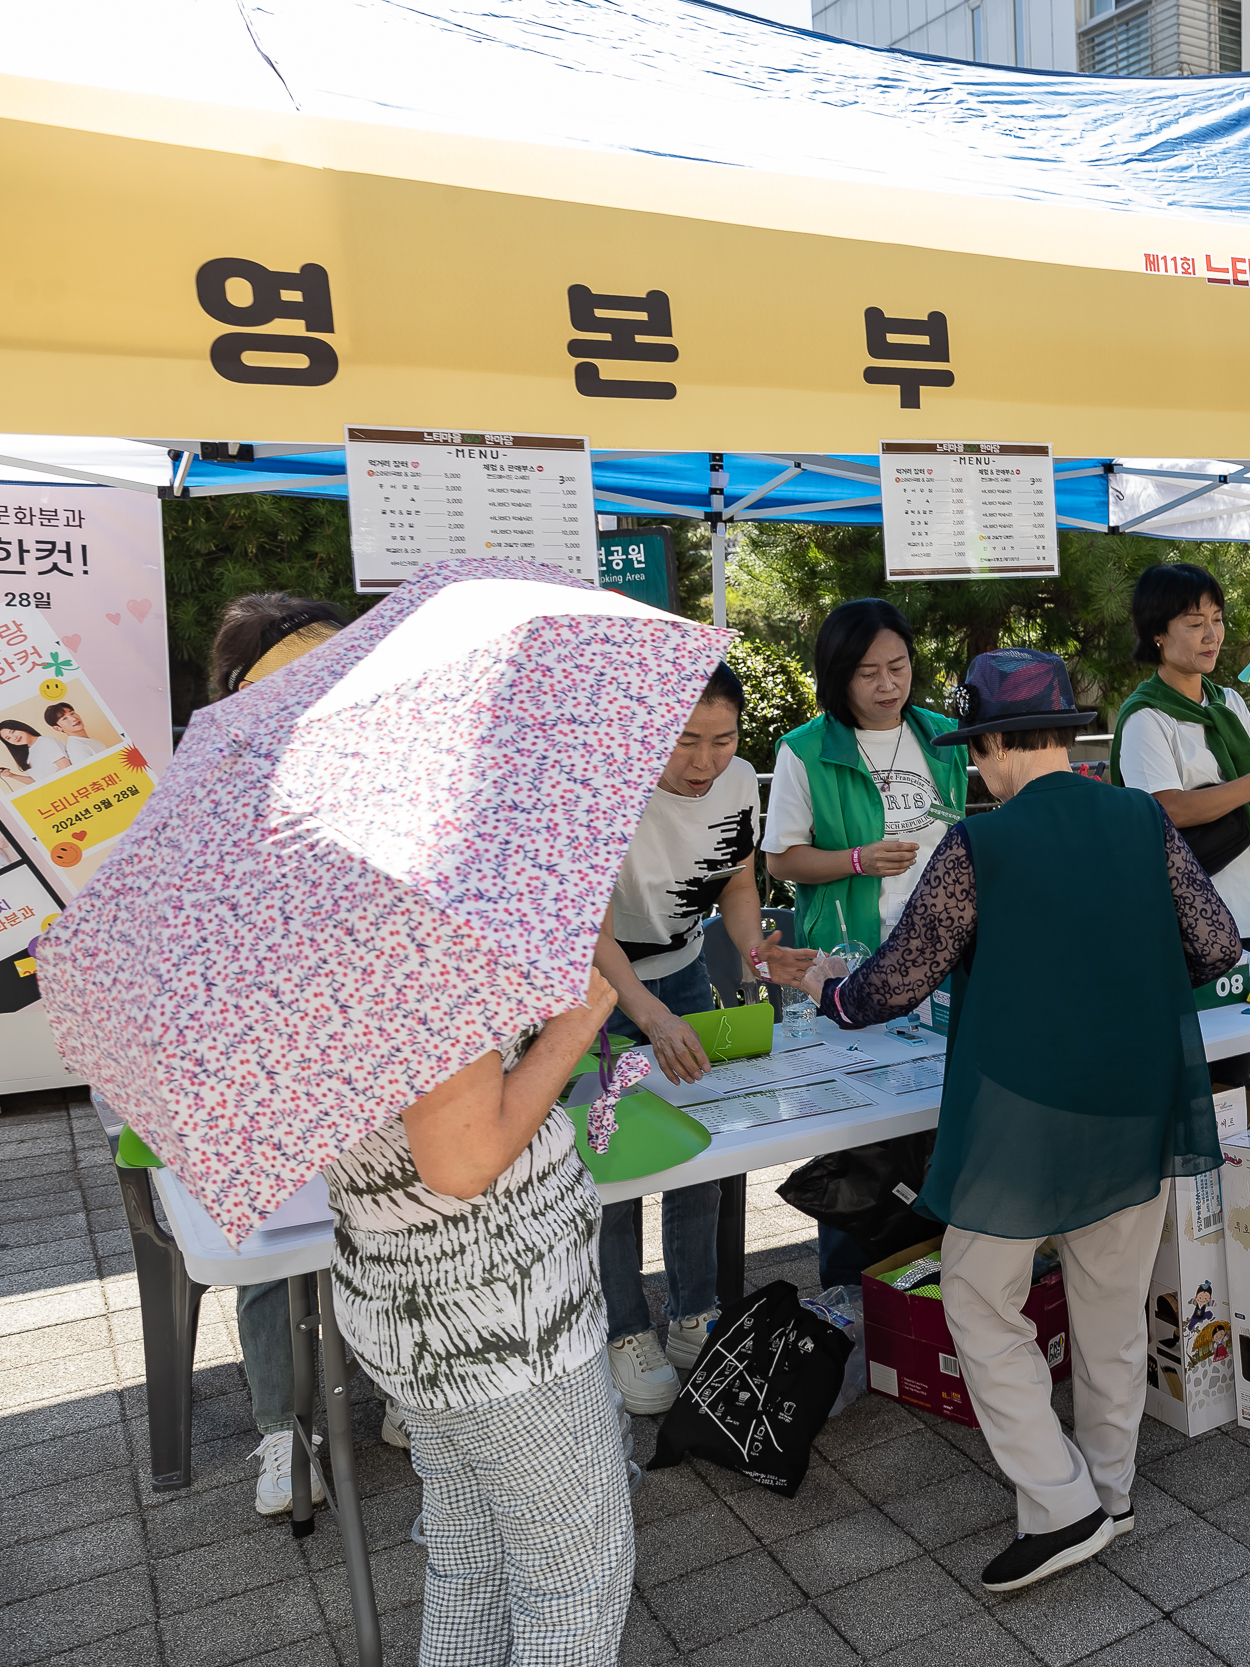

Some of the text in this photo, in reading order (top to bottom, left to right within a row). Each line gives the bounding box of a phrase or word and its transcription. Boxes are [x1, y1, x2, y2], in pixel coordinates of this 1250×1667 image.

[1144, 253, 1196, 276] 제11회
[424, 432, 514, 446] 느티마을 한마당
[626, 572, 645, 581] Area
[4, 592, 52, 610] 28일
[37, 772, 123, 820] 느티나무축제!
[885, 793, 925, 810] RIS
[52, 784, 141, 834] 2024년 9월 28일
[1216, 974, 1244, 997] 08
